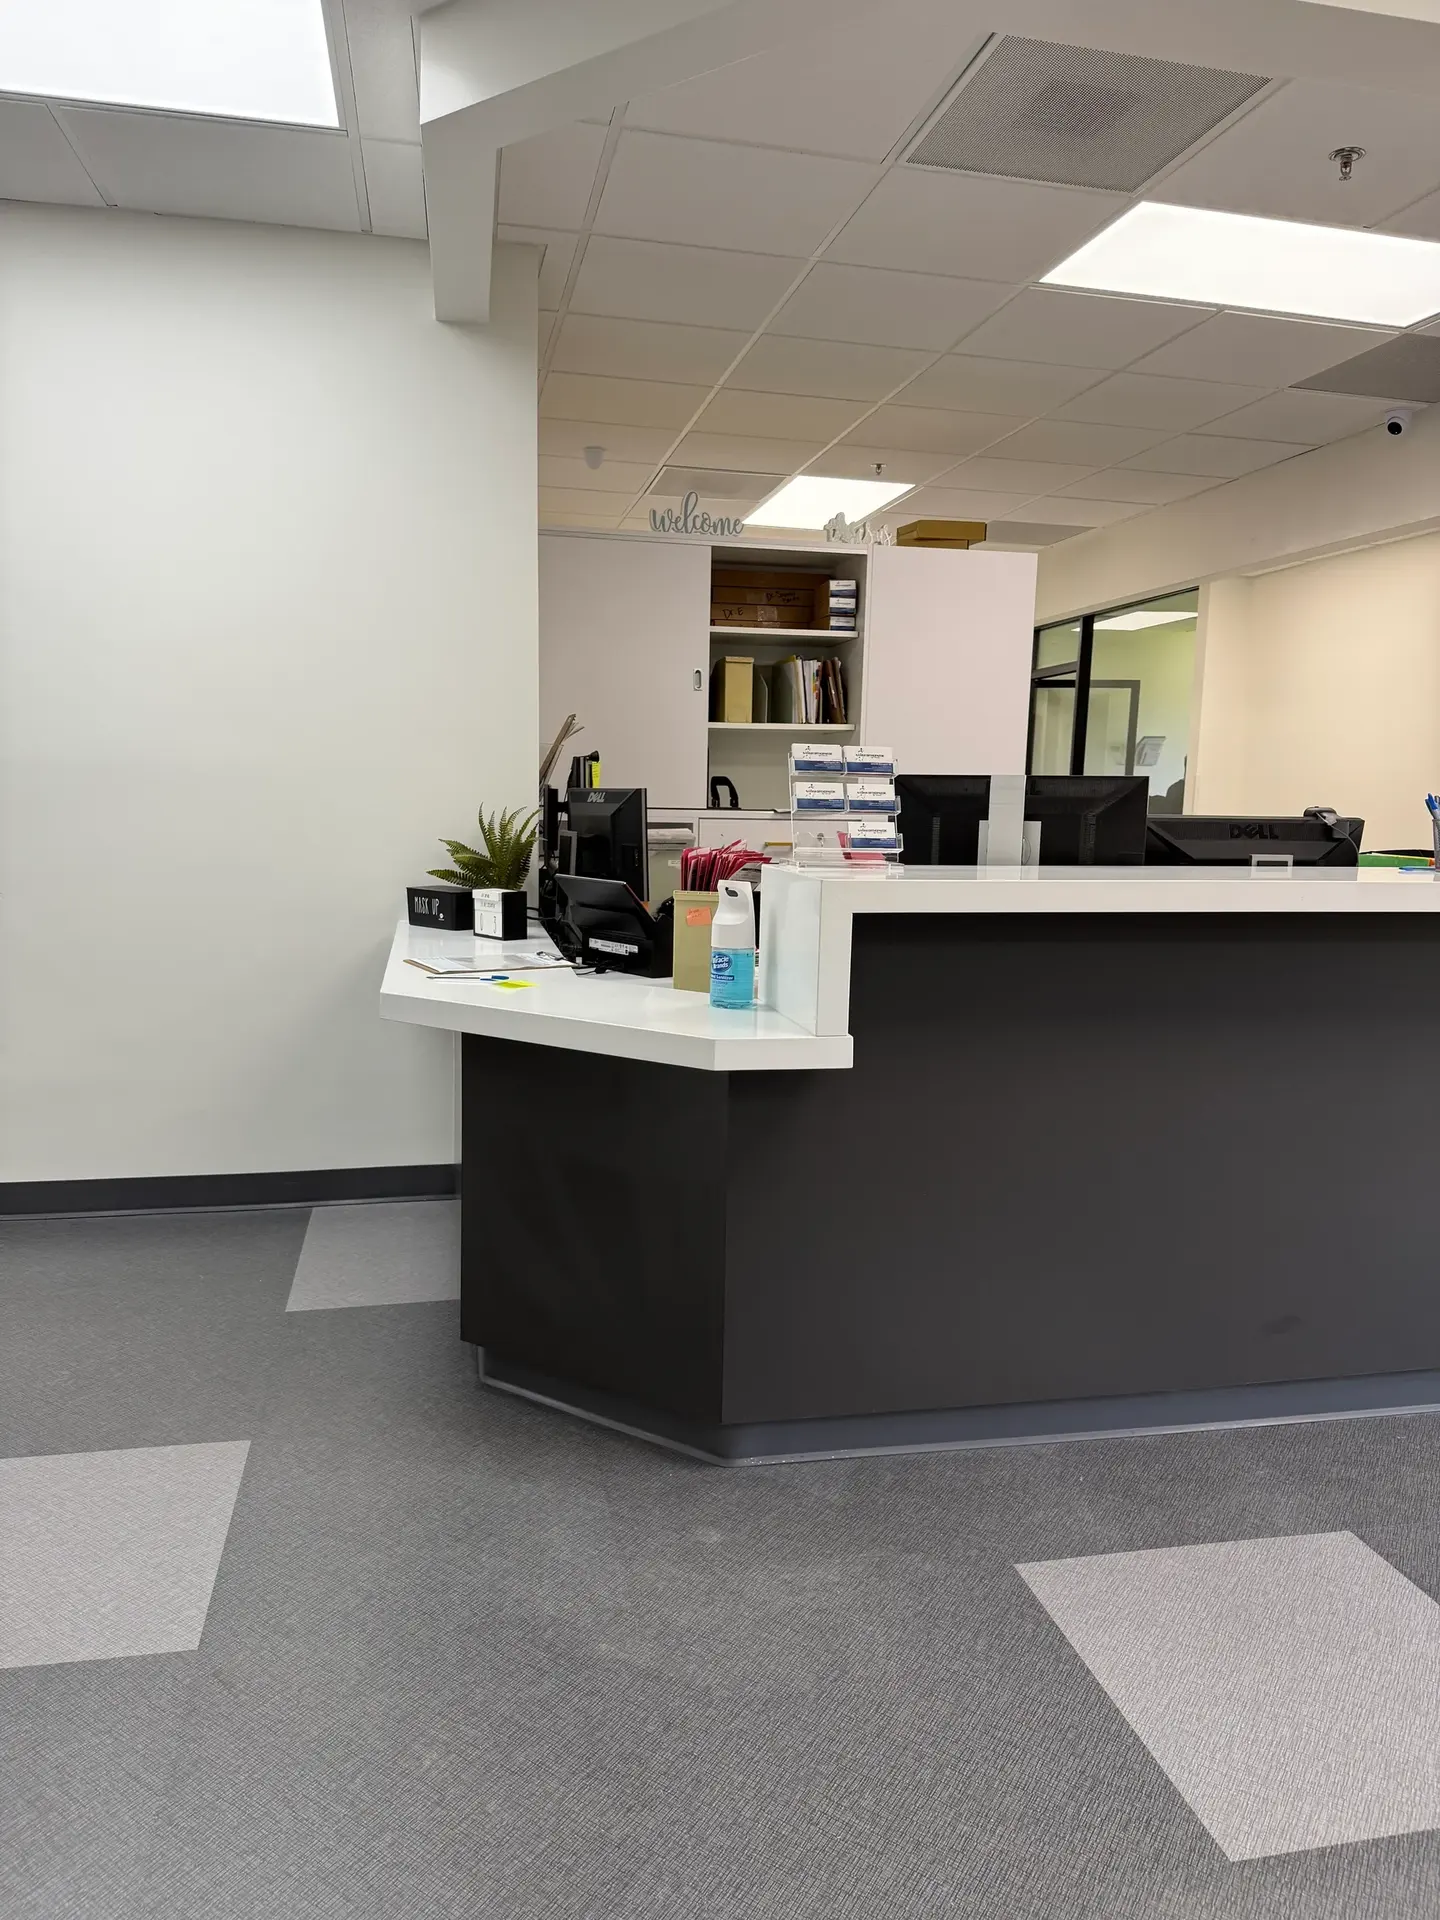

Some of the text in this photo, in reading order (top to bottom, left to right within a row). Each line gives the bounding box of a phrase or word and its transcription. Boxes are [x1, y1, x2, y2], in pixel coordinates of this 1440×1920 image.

[650, 491, 744, 536] welcome
[587, 791, 605, 803] DELL
[1229, 823, 1279, 840] DELL
[414, 896, 440, 916] MASK UP
